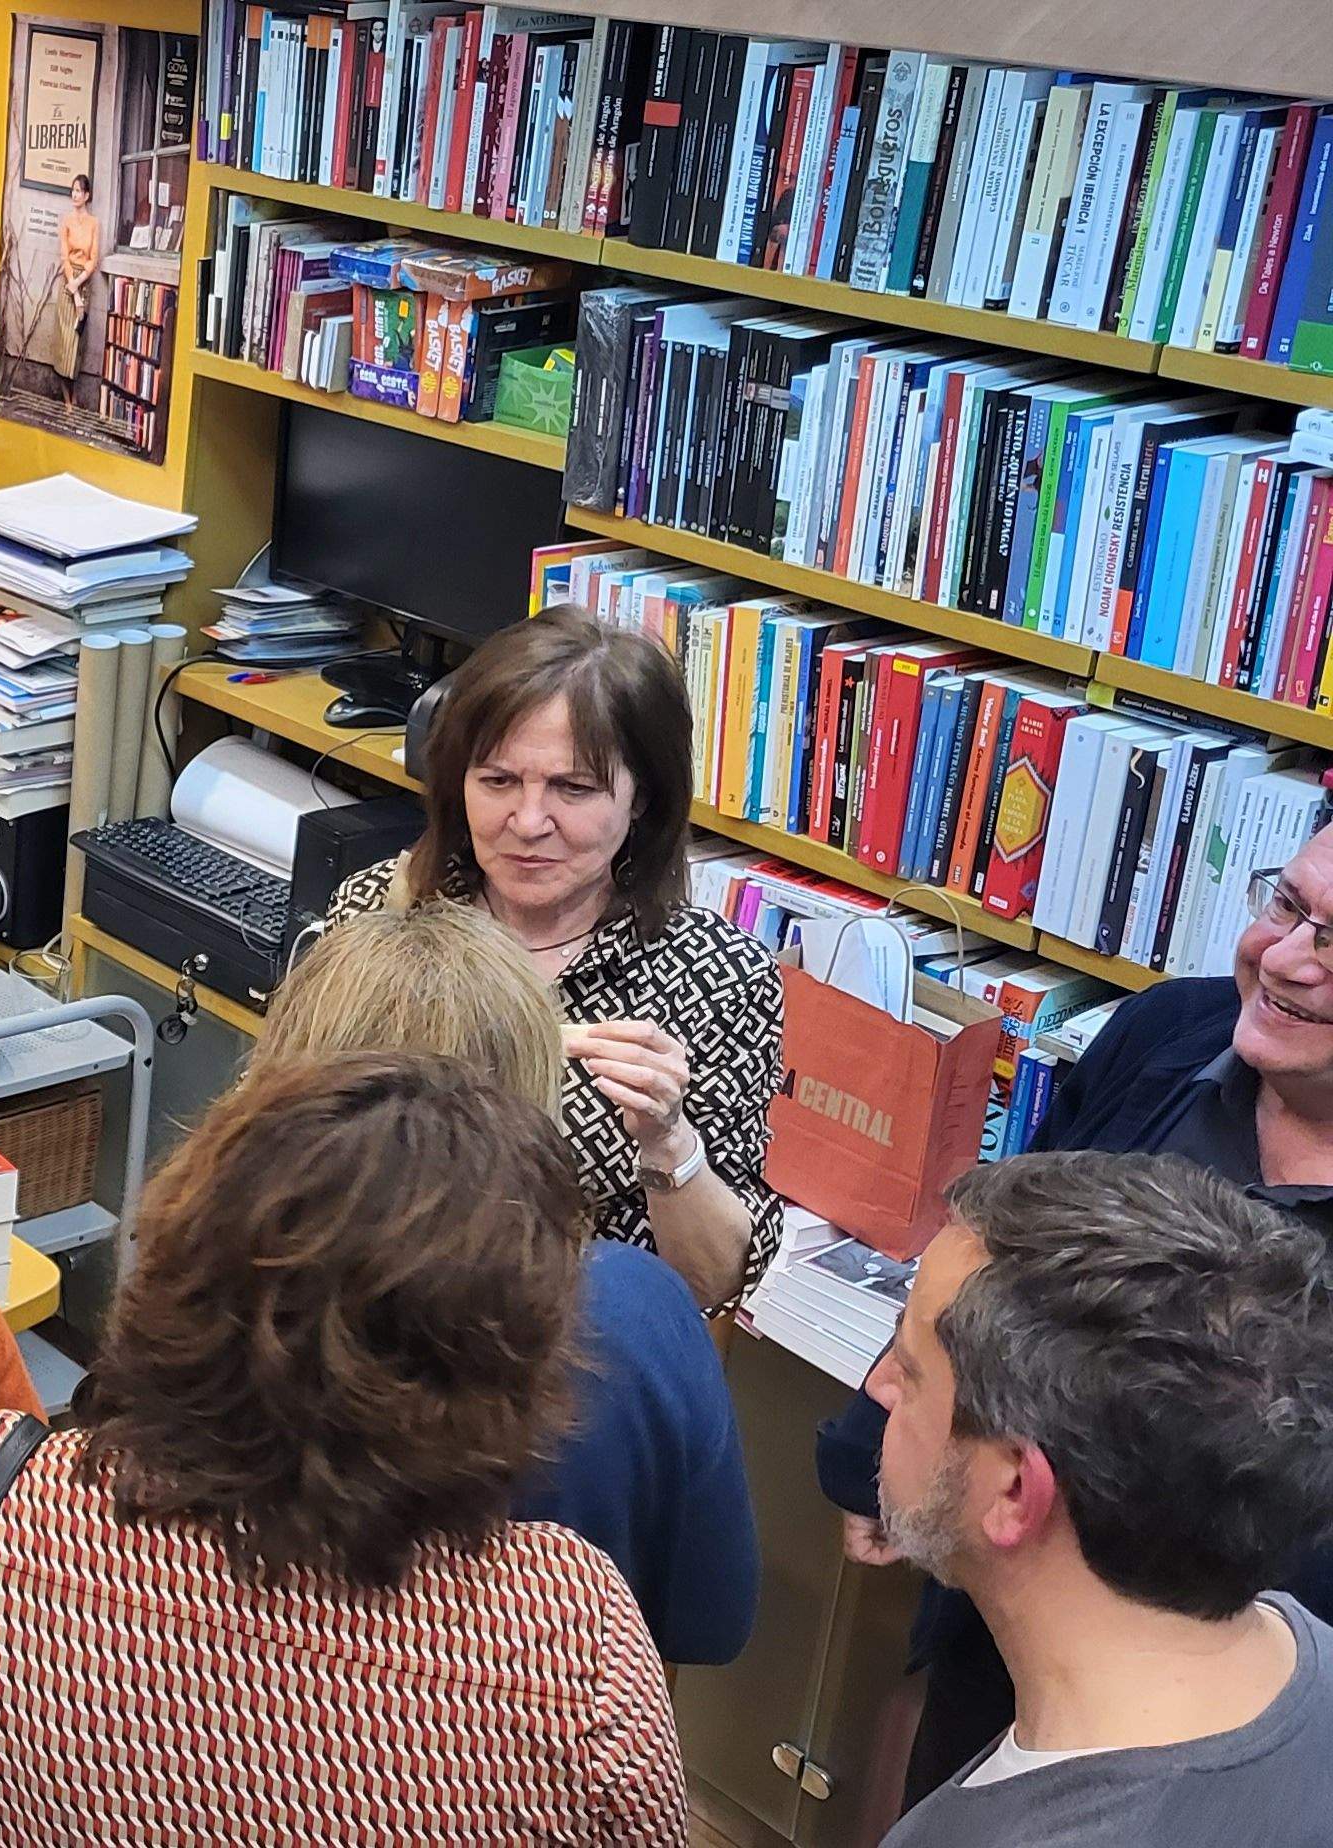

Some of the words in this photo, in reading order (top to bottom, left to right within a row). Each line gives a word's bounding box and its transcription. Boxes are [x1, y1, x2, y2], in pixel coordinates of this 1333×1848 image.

[659, 25, 670, 53] OLVIDO
[167, 62, 188, 73] GOYA
[657, 53, 666, 69] DEL
[654, 86, 661, 97] LA
[655, 69, 664, 85] VOZ
[507, 81, 520, 108] apoyo
[1098, 102, 1112, 118] LA
[597, 95, 613, 132] Aragón
[608, 97, 625, 134] Aragón
[28, 116, 87, 150] LIBRERÍA
[596, 132, 606, 146] de
[607, 134, 618, 149] de
[1085, 119, 1111, 182] EXCEPCIÓN
[587, 147, 605, 200] Libertarios
[598, 149, 616, 203] Libertarios
[746, 155, 764, 200] MAQUIS!
[744, 201, 757, 215] EL
[1076, 183, 1099, 227] IBÉRICA
[739, 217, 756, 246] ¡VIVA
[1268, 213, 1284, 249] Newton
[491, 266, 533, 295] BASKET
[1060, 243, 1079, 288] TÍSCAR
[1261, 256, 1275, 280] Tales
[1258, 281, 1270, 295] De
[425, 320, 443, 372] BASKET
[447, 324, 464, 377] BASKET
[842, 353, 850, 364] 5
[1016, 408, 1027, 419] Y
[1010, 419, 1027, 452] ESTO,
[1110, 441, 1122, 472] SELLARS
[1134, 439, 1157, 501] Retratarte
[1003, 456, 1024, 501] ¿QUIÉN
[1106, 473, 1117, 494] JOHN
[884, 491, 896, 517] COSTA
[1002, 501, 1015, 518] LO
[1110, 462, 1134, 532] RESISTENCIA
[996, 518, 1013, 556] PAGA?
[1090, 532, 1110, 593] ESTOICISMO
[1103, 532, 1122, 585] CHOMSKY
[1098, 586, 1113, 617] NOAM
[955, 705, 968, 740] MUNDO
[977, 727, 990, 747] Smil
[1021, 724, 1043, 738] ARANA
[1022, 716, 1043, 728] MARIE
[946, 741, 964, 786] EXTRAÑO
[1186, 762, 1201, 788] ŽIŽEK
[940, 787, 954, 820] ISABEL
[966, 773, 980, 809] funciona
[1180, 789, 1195, 824] SLAVOJ
[964, 811, 973, 820] el
[958, 821, 970, 851] mundo
[1005, 1000, 1025, 1061] DROGAS
[798, 1076, 894, 1149] CENTRAL
